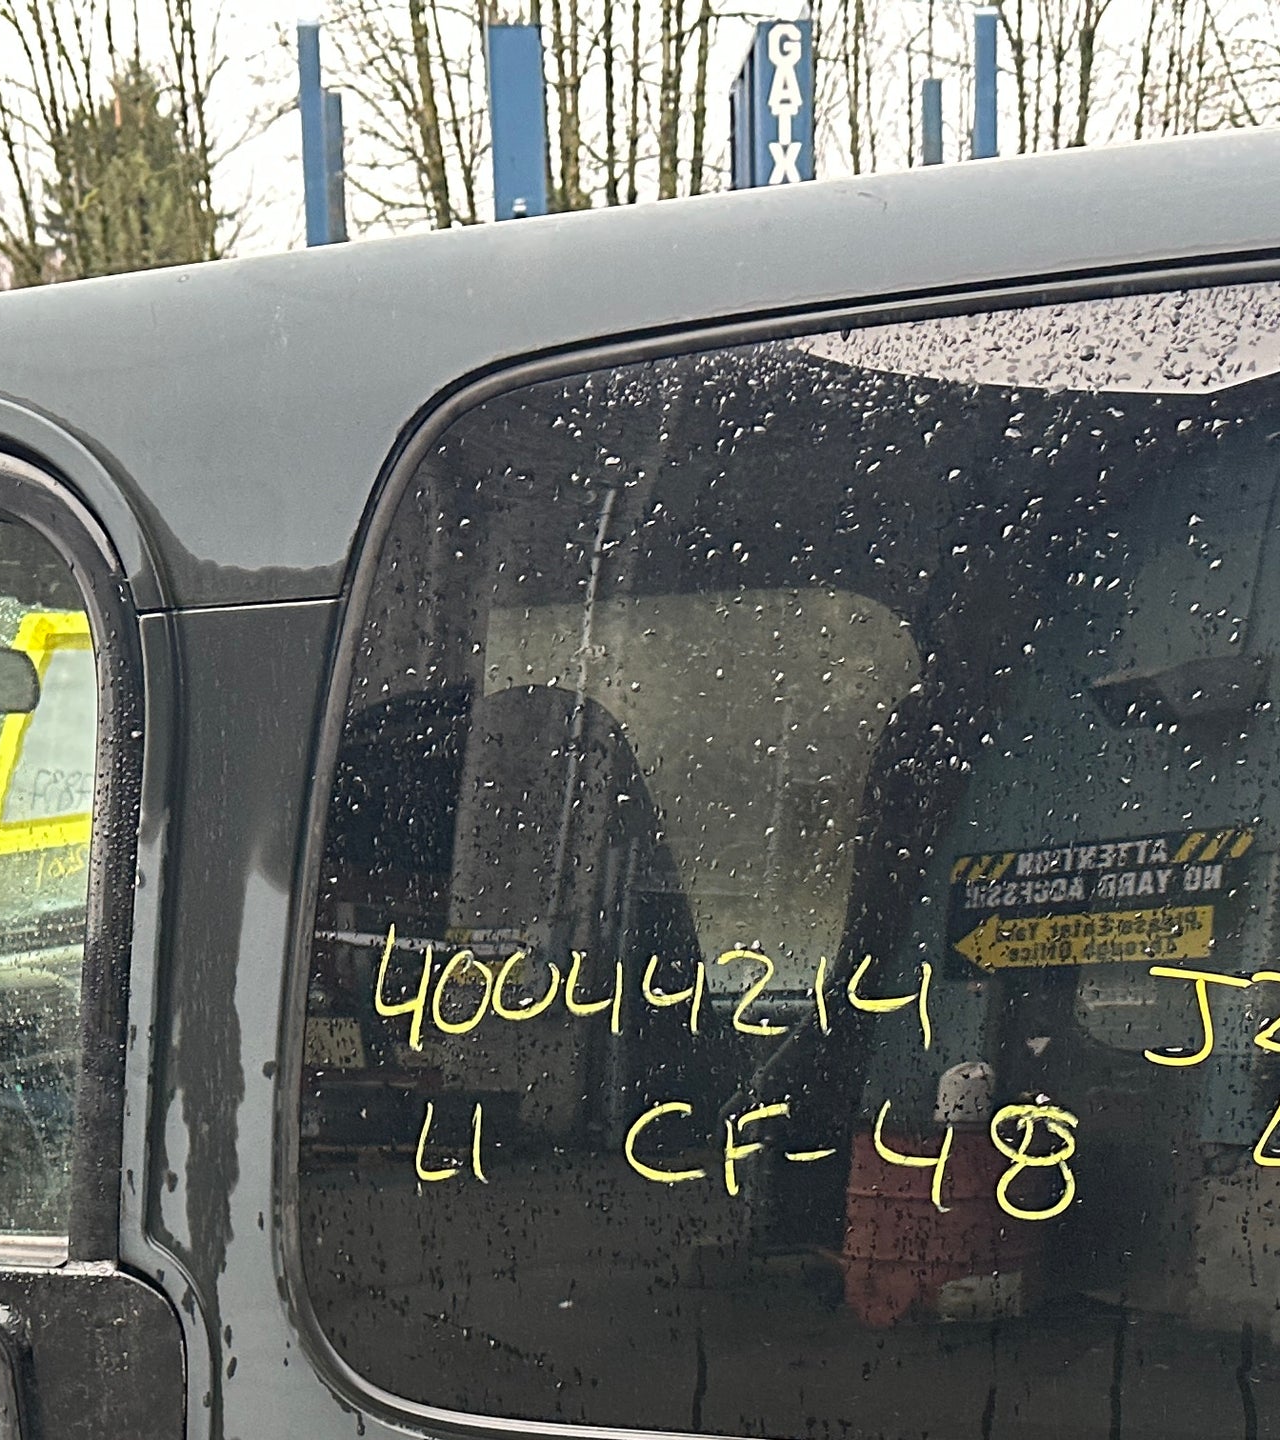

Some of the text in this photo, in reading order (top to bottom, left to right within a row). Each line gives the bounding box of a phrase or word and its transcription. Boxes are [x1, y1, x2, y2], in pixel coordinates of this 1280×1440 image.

[768, 23, 803, 184] GATX
[374, 923, 932, 1052] 40044214
[624, 1100, 1079, 1221] CF-48
